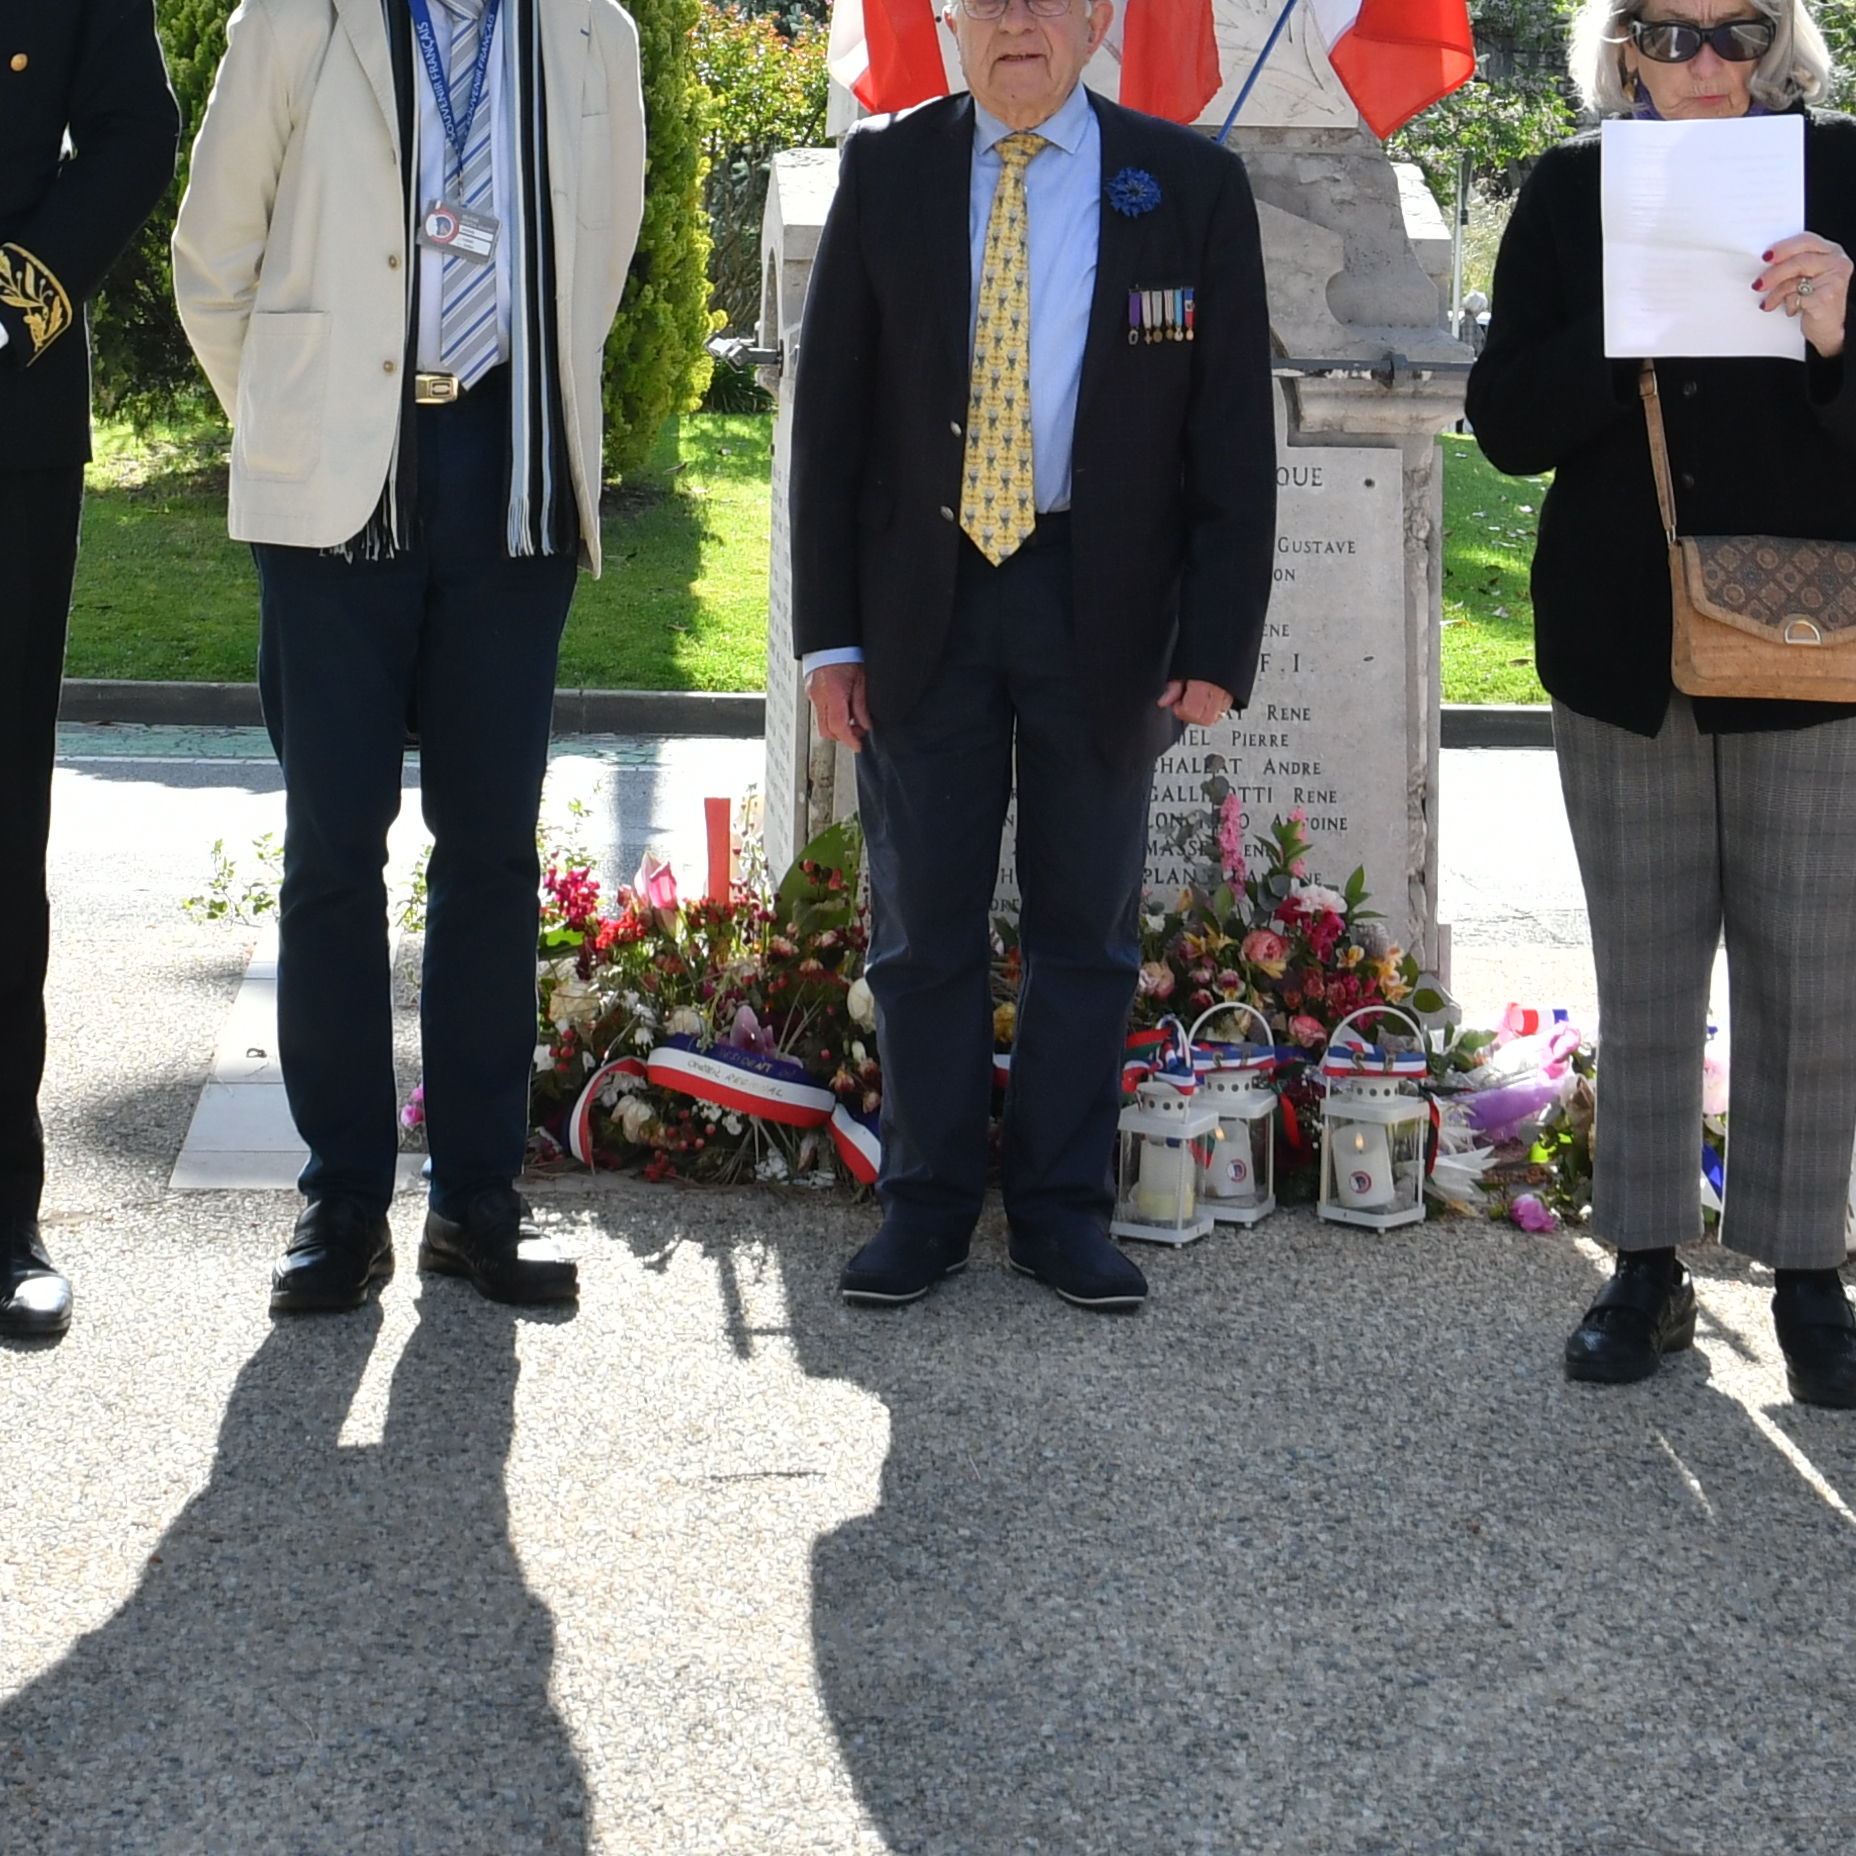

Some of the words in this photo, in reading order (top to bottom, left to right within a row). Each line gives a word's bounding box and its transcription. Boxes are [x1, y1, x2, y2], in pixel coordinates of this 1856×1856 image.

[416, 22, 441, 81] FRANÇAIS
[1278, 536, 1356, 555] GUSTAVE
[1267, 704, 1311, 721] RENE
[1231, 730, 1289, 747] PIERRE
[1263, 758, 1321, 775] ANDRE
[1294, 787, 1337, 804] RENE
